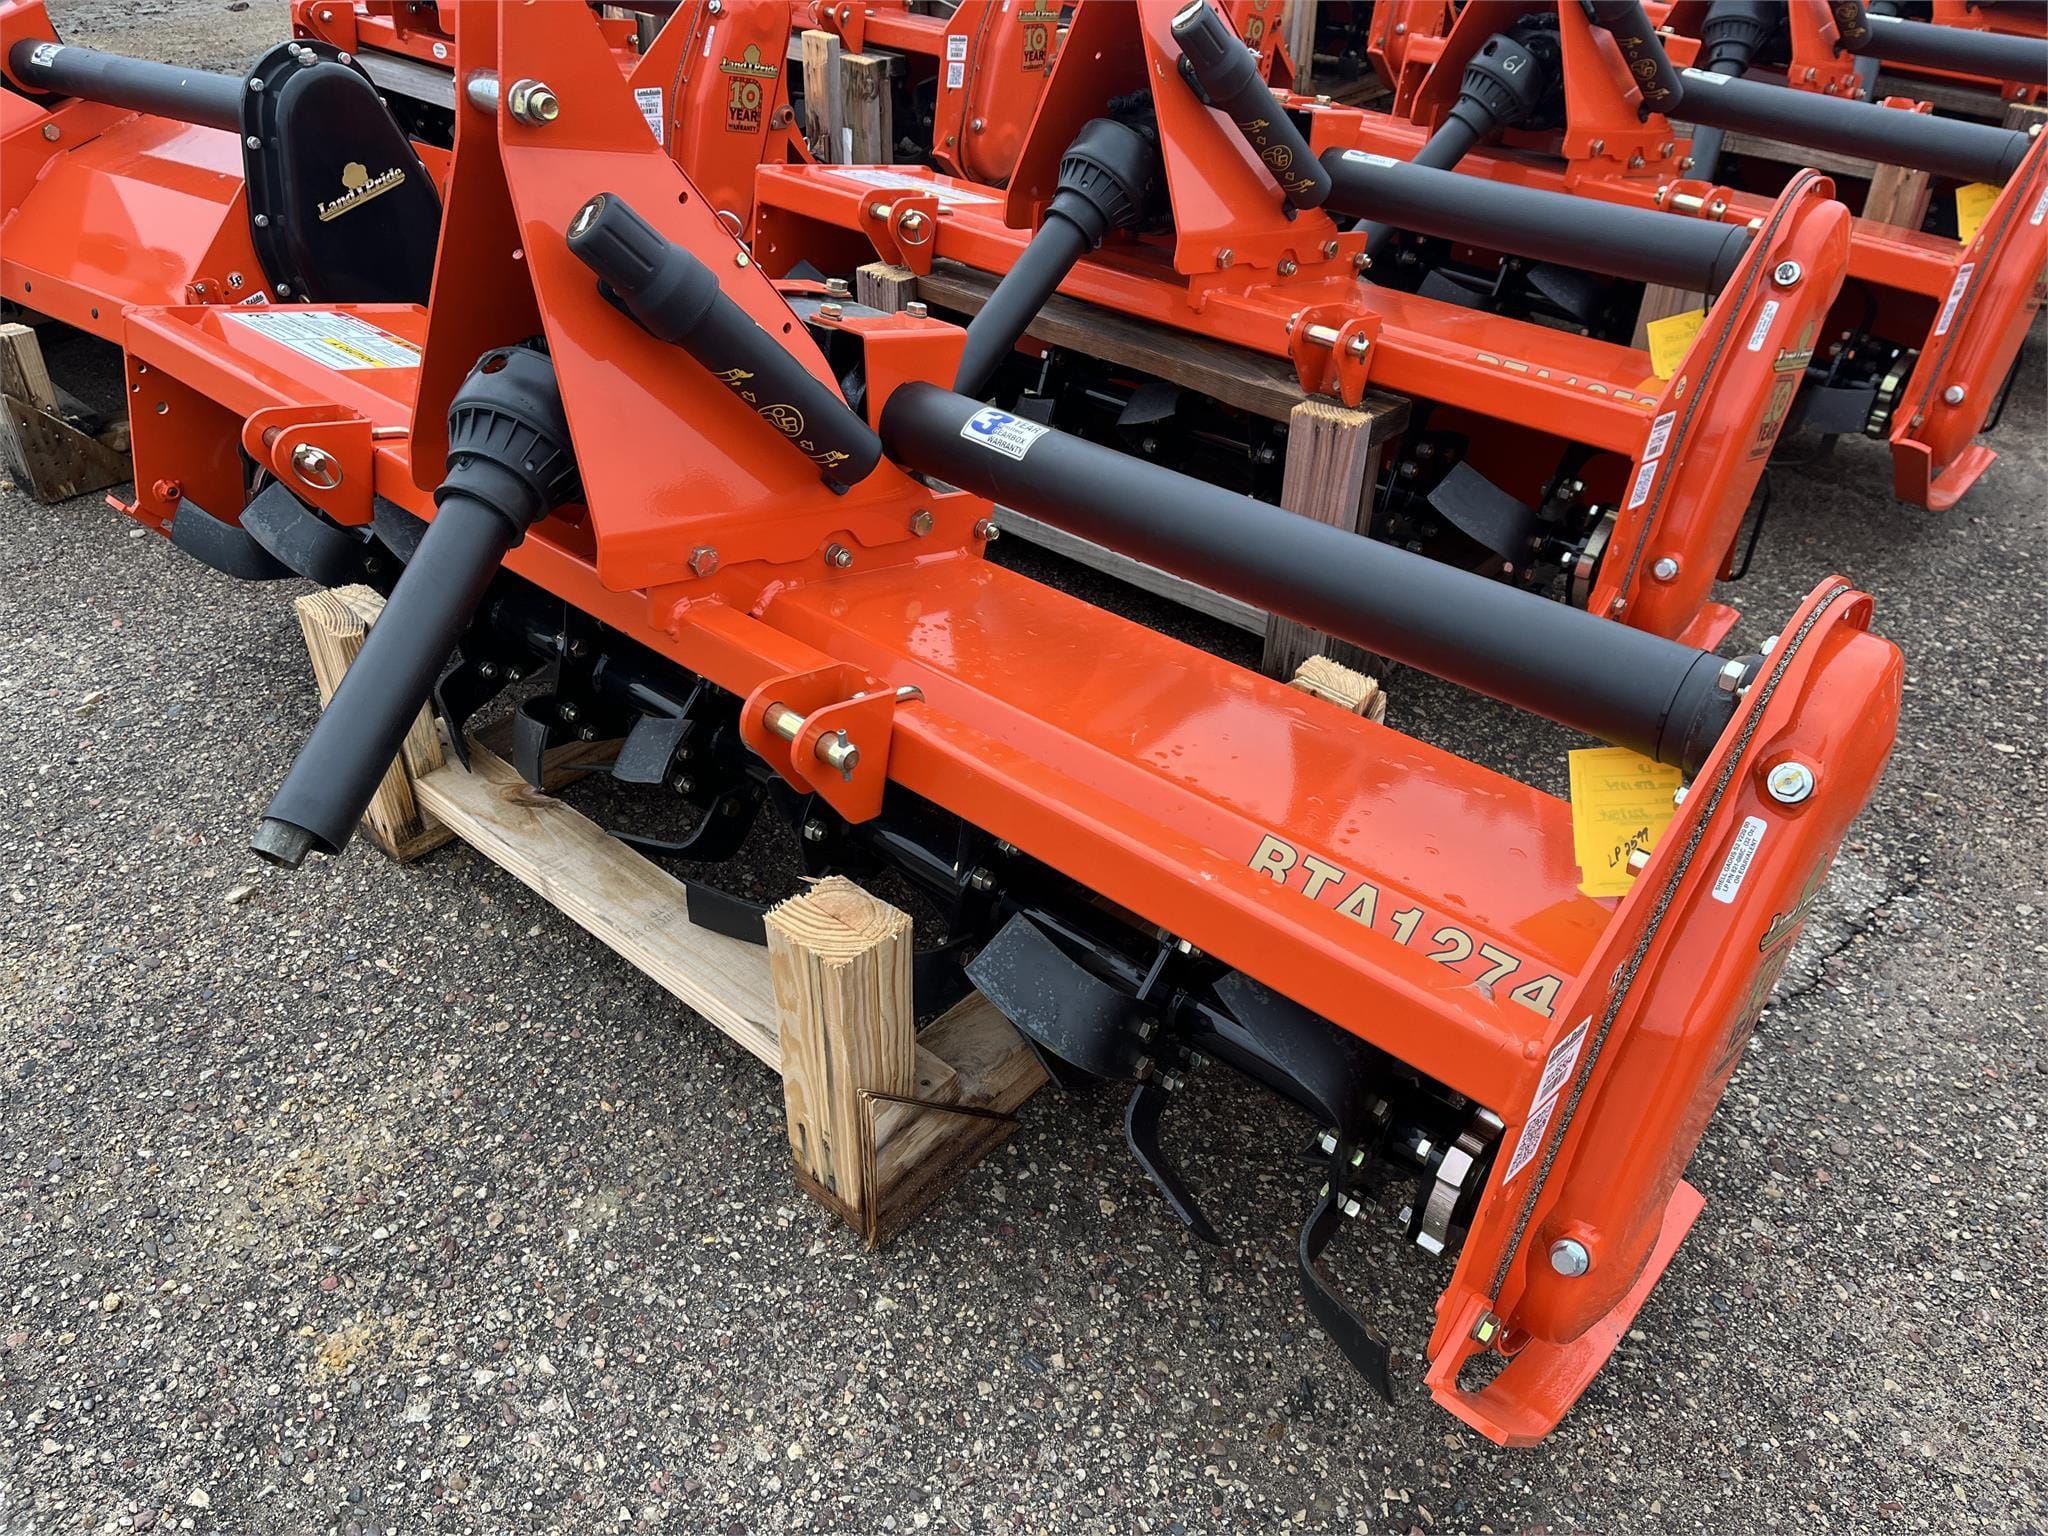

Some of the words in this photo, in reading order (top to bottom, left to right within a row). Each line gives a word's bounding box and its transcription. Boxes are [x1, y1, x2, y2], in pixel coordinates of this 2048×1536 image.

[1024, 26, 1047, 52] 10
[1023, 50, 1046, 62] YEAR
[729, 80, 761, 110] 10
[729, 107, 759, 123] YEAR
[317, 188, 356, 215] Land
[365, 166, 403, 190] Pride
[970, 411, 1016, 436] 3
[1015, 419, 1042, 435] YEAR
[992, 426, 1026, 445] GEARBOX
[986, 435, 1023, 455] WARRANTY
[1714, 870, 1728, 892] SHELL
[1724, 850, 1738, 872] GADUS
[1733, 874, 1742, 885] OR
[1738, 838, 1759, 876] EQUIVALENT
[1722, 883, 1730, 893] LP
[1247, 833, 1564, 1019] RTA1274
